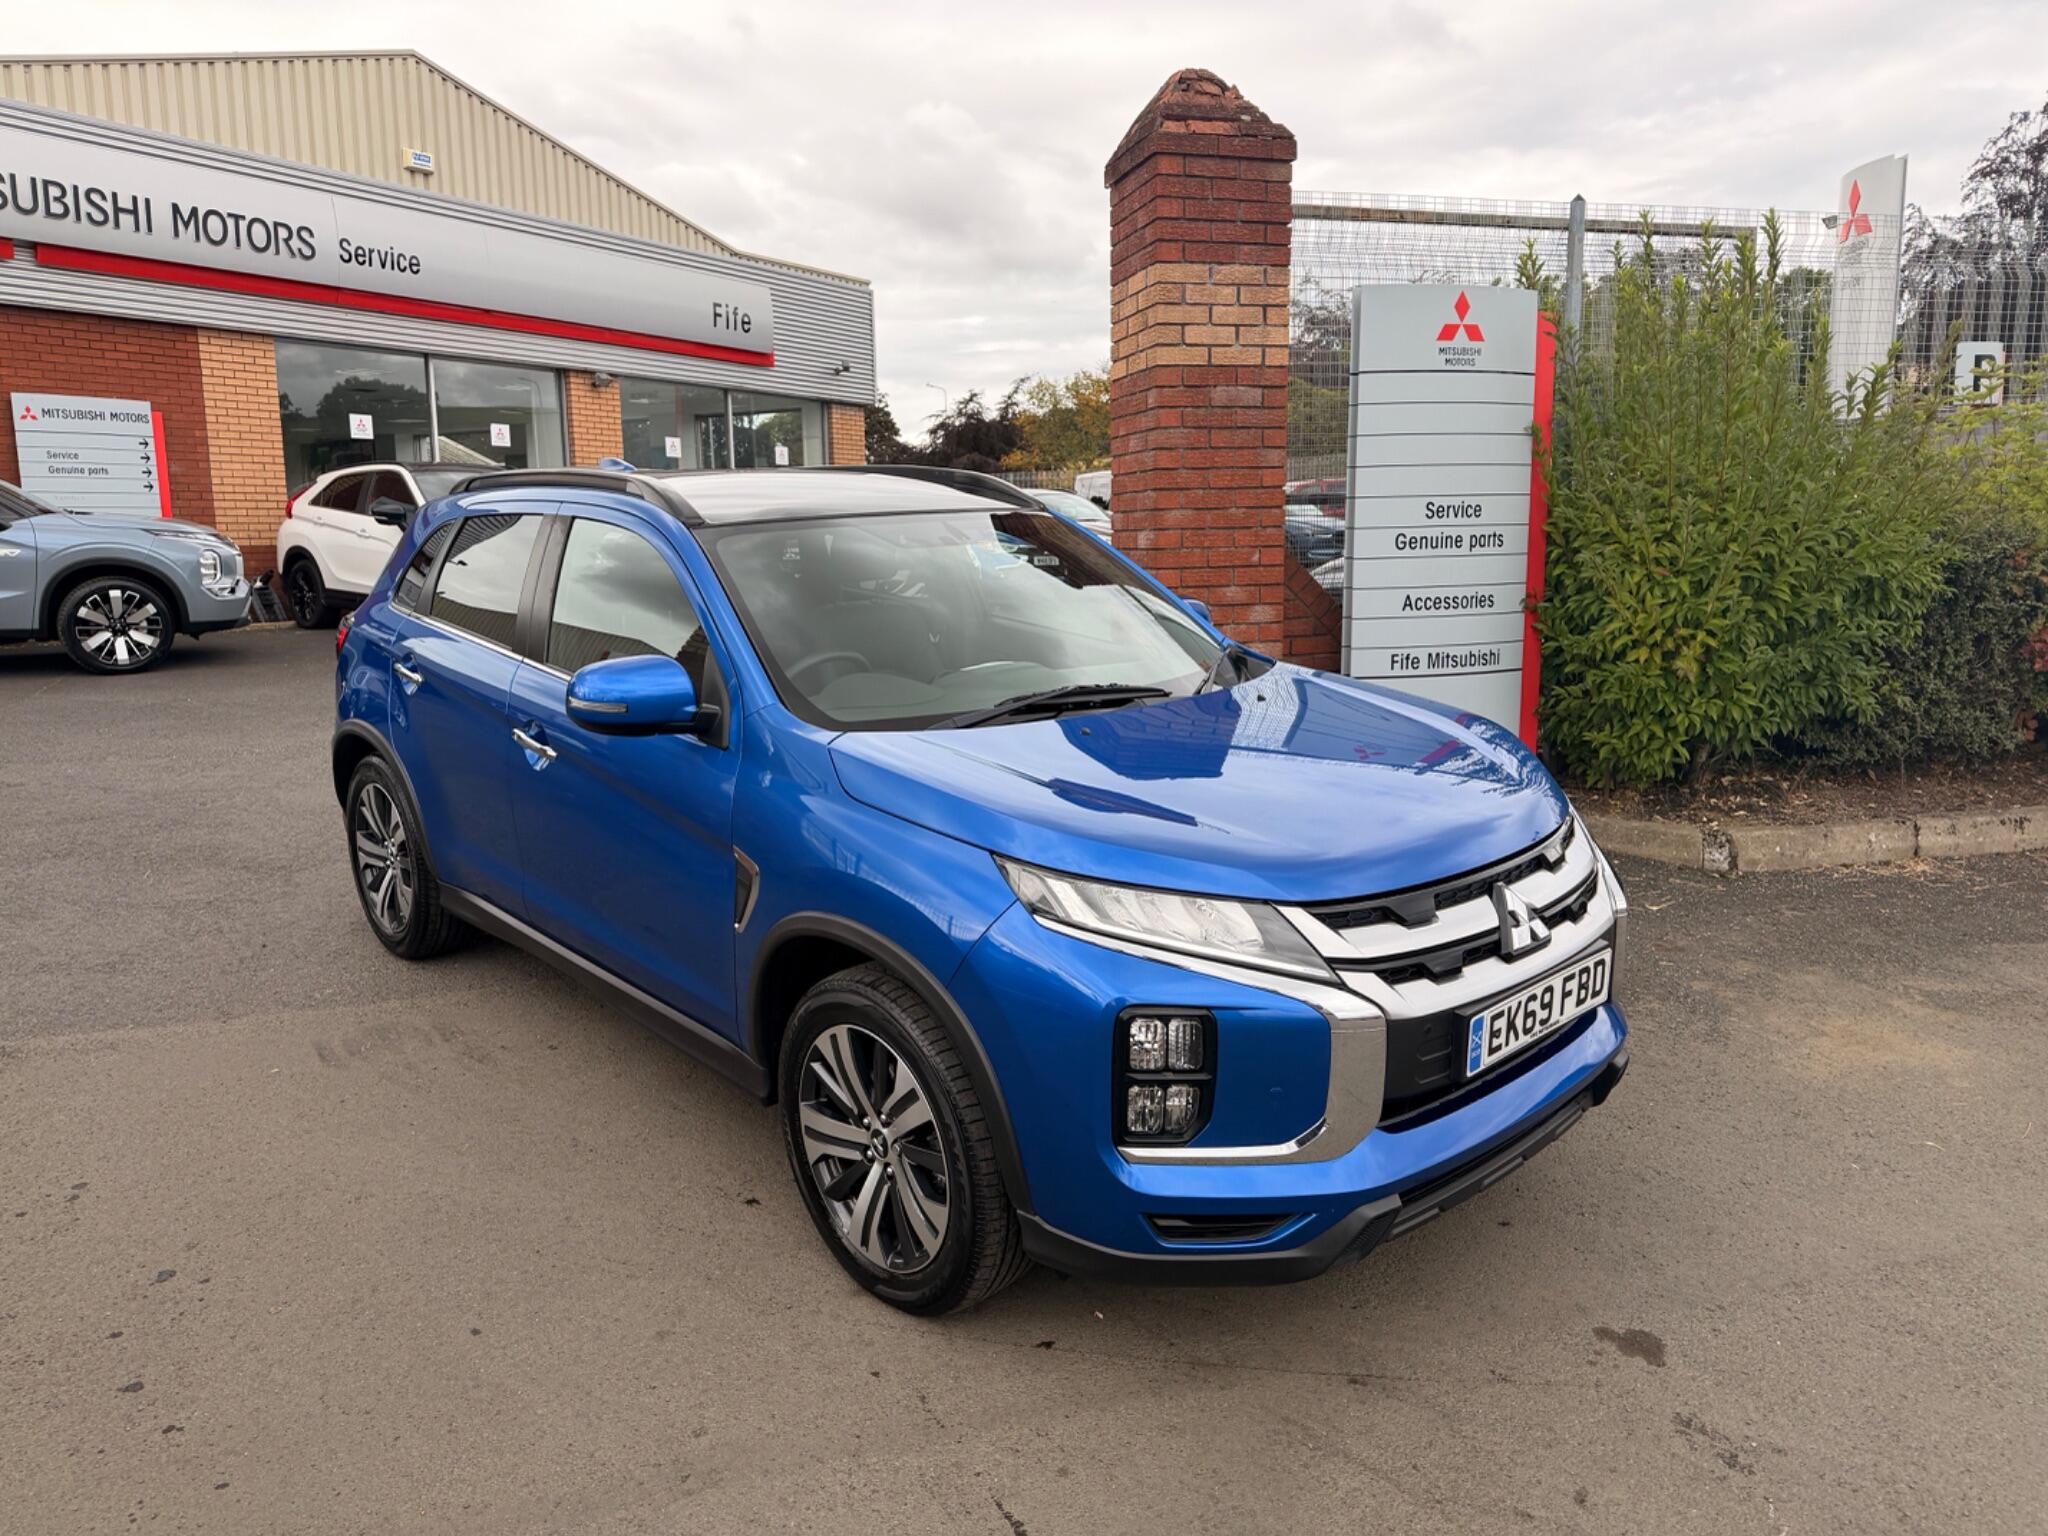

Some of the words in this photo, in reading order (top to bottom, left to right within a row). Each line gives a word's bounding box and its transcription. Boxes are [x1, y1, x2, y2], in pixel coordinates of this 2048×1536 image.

[171, 202, 317, 261] MOTORS
[338, 237, 422, 275] Service
[712, 302, 752, 334] Fife
[1438, 346, 1482, 356] MITSUBISHI
[1445, 357, 1476, 366] MOTORS
[41, 407, 106, 421] MITSUBISHI
[110, 411, 150, 424] MOTORS
[46, 450, 79, 460] Service
[48, 465, 85, 475] Genuine
[88, 466, 109, 477] parts
[1425, 500, 1483, 519] Service
[1394, 531, 1464, 551] Genuine
[1469, 531, 1504, 552] parts
[1401, 591, 1495, 612] Accessories
[1390, 653, 1421, 671] Fife
[1427, 648, 1501, 670] Mitsubishi
[1488, 984, 1554, 1057] EK69
[1560, 957, 1606, 1017] FBD
